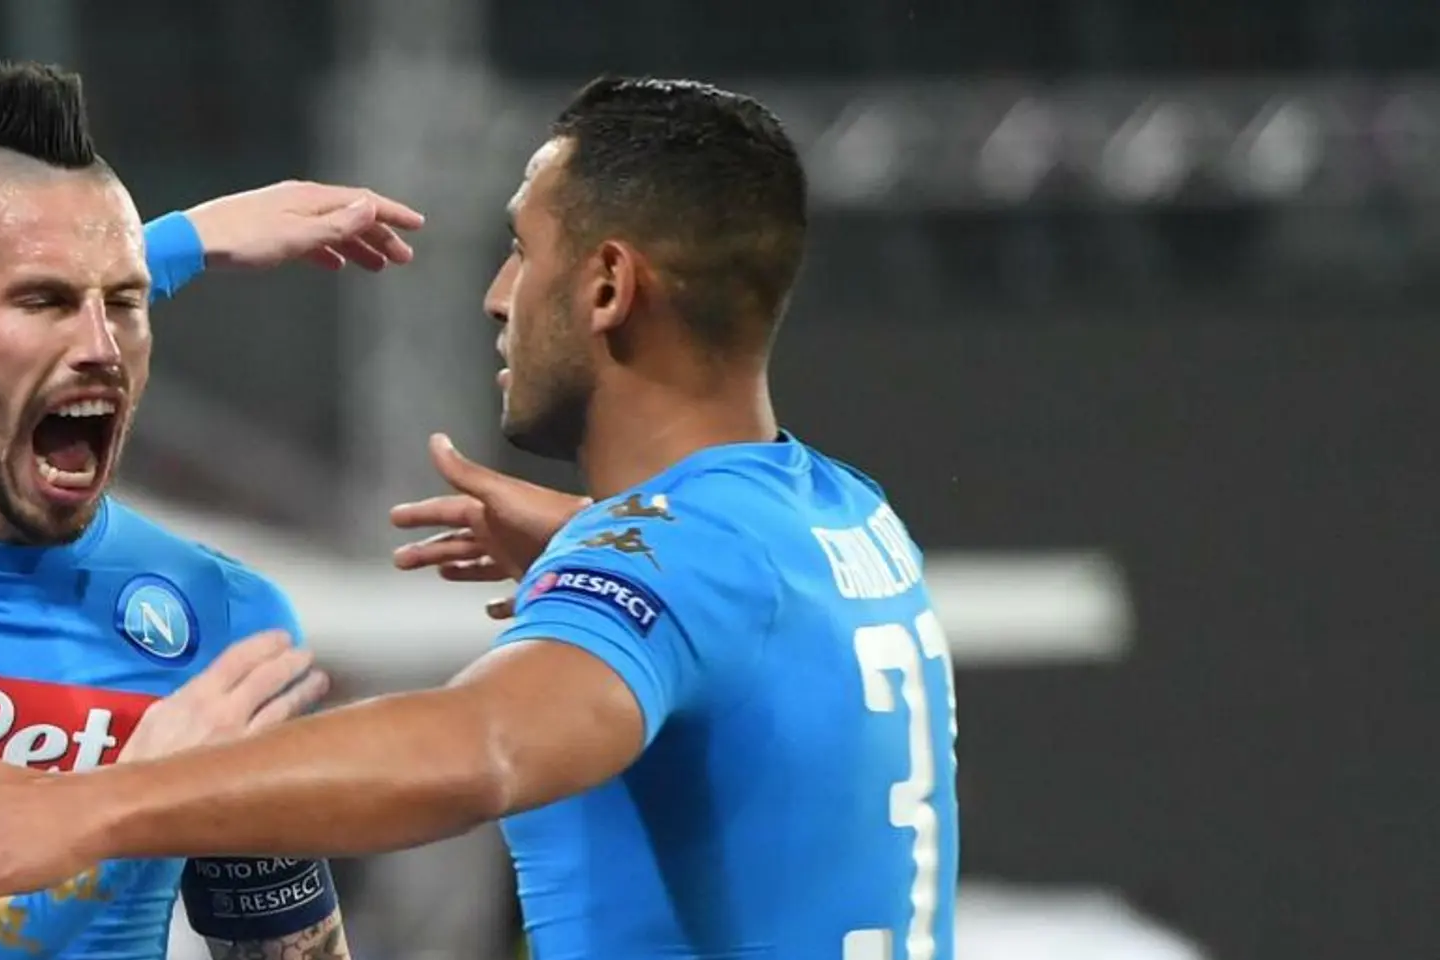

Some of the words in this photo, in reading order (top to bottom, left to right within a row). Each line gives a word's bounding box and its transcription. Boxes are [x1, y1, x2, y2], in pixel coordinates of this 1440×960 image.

[556, 573, 656, 625] RESPECT
[139, 601, 174, 646] N
[226, 863, 252, 879] TO
[240, 869, 322, 913] RESPECT
